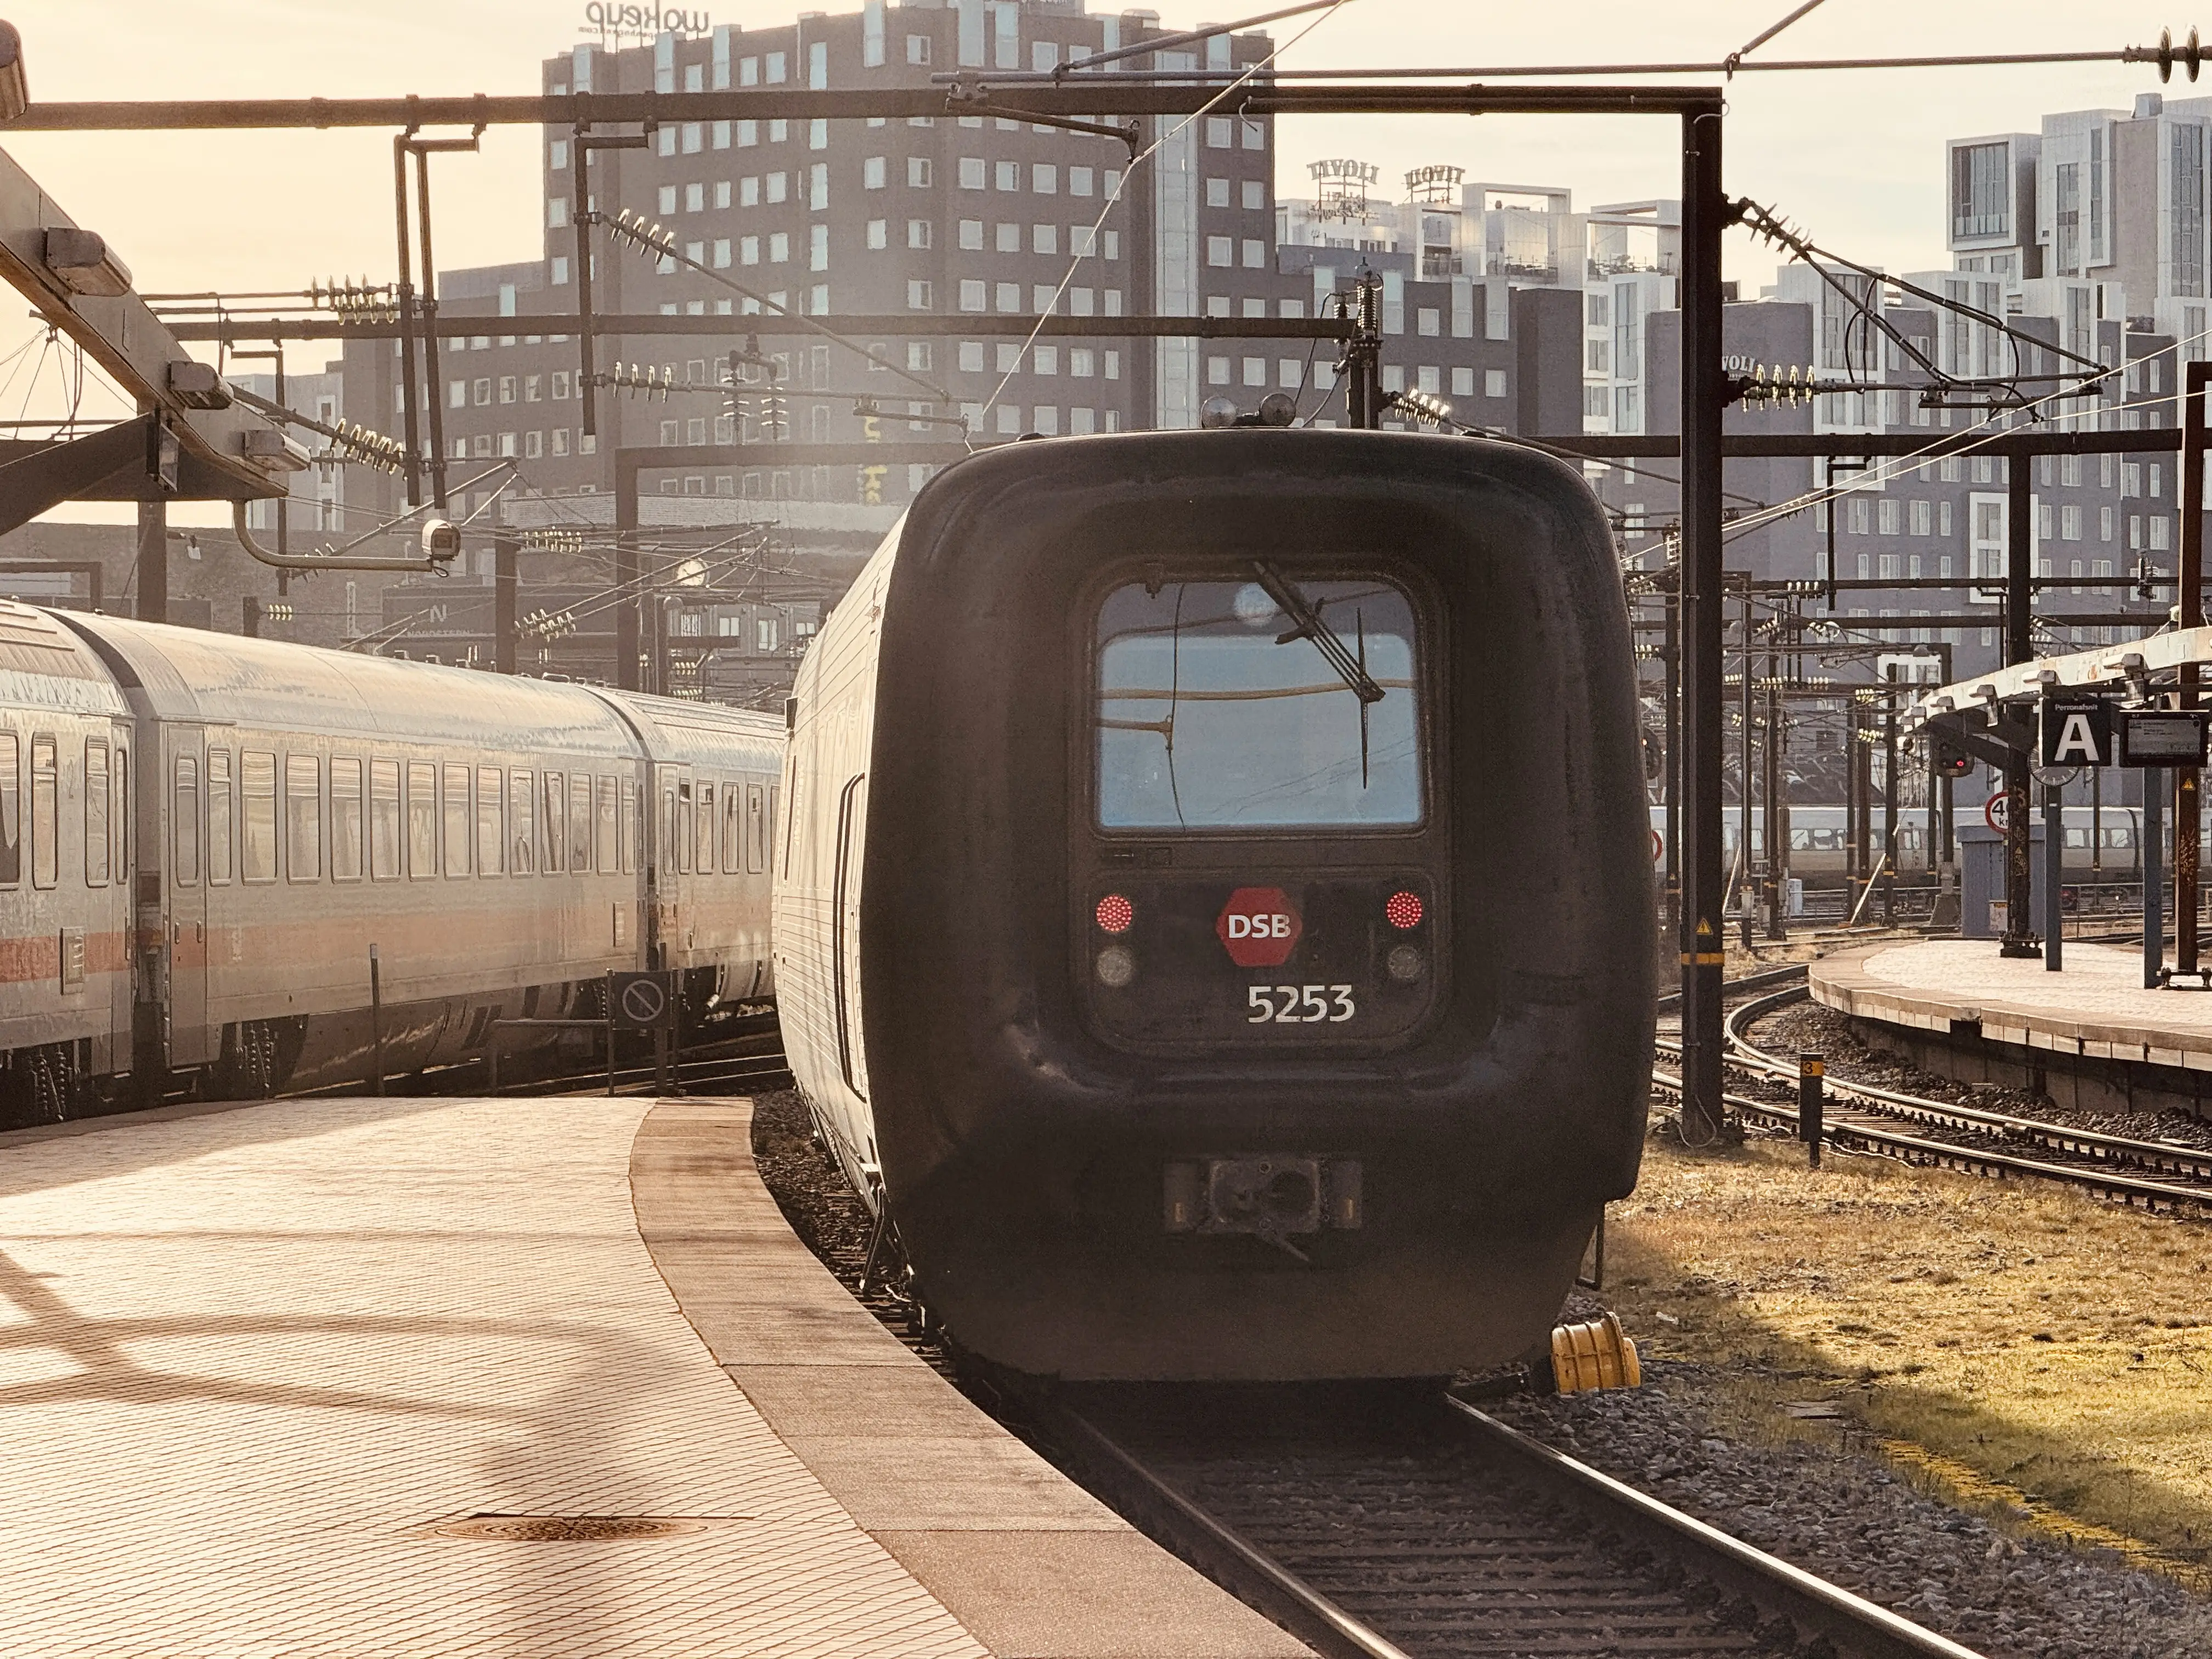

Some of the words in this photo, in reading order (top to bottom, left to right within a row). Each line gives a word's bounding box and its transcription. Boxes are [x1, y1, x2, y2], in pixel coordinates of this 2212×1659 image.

[1306, 159, 1380, 184] TIVOLI
[1722, 354, 1754, 373] VOLI
[2055, 714, 2100, 761] A
[1991, 800, 2008, 816] 4
[1228, 914, 1291, 938] DSB
[1248, 985, 1355, 1023] 5253
